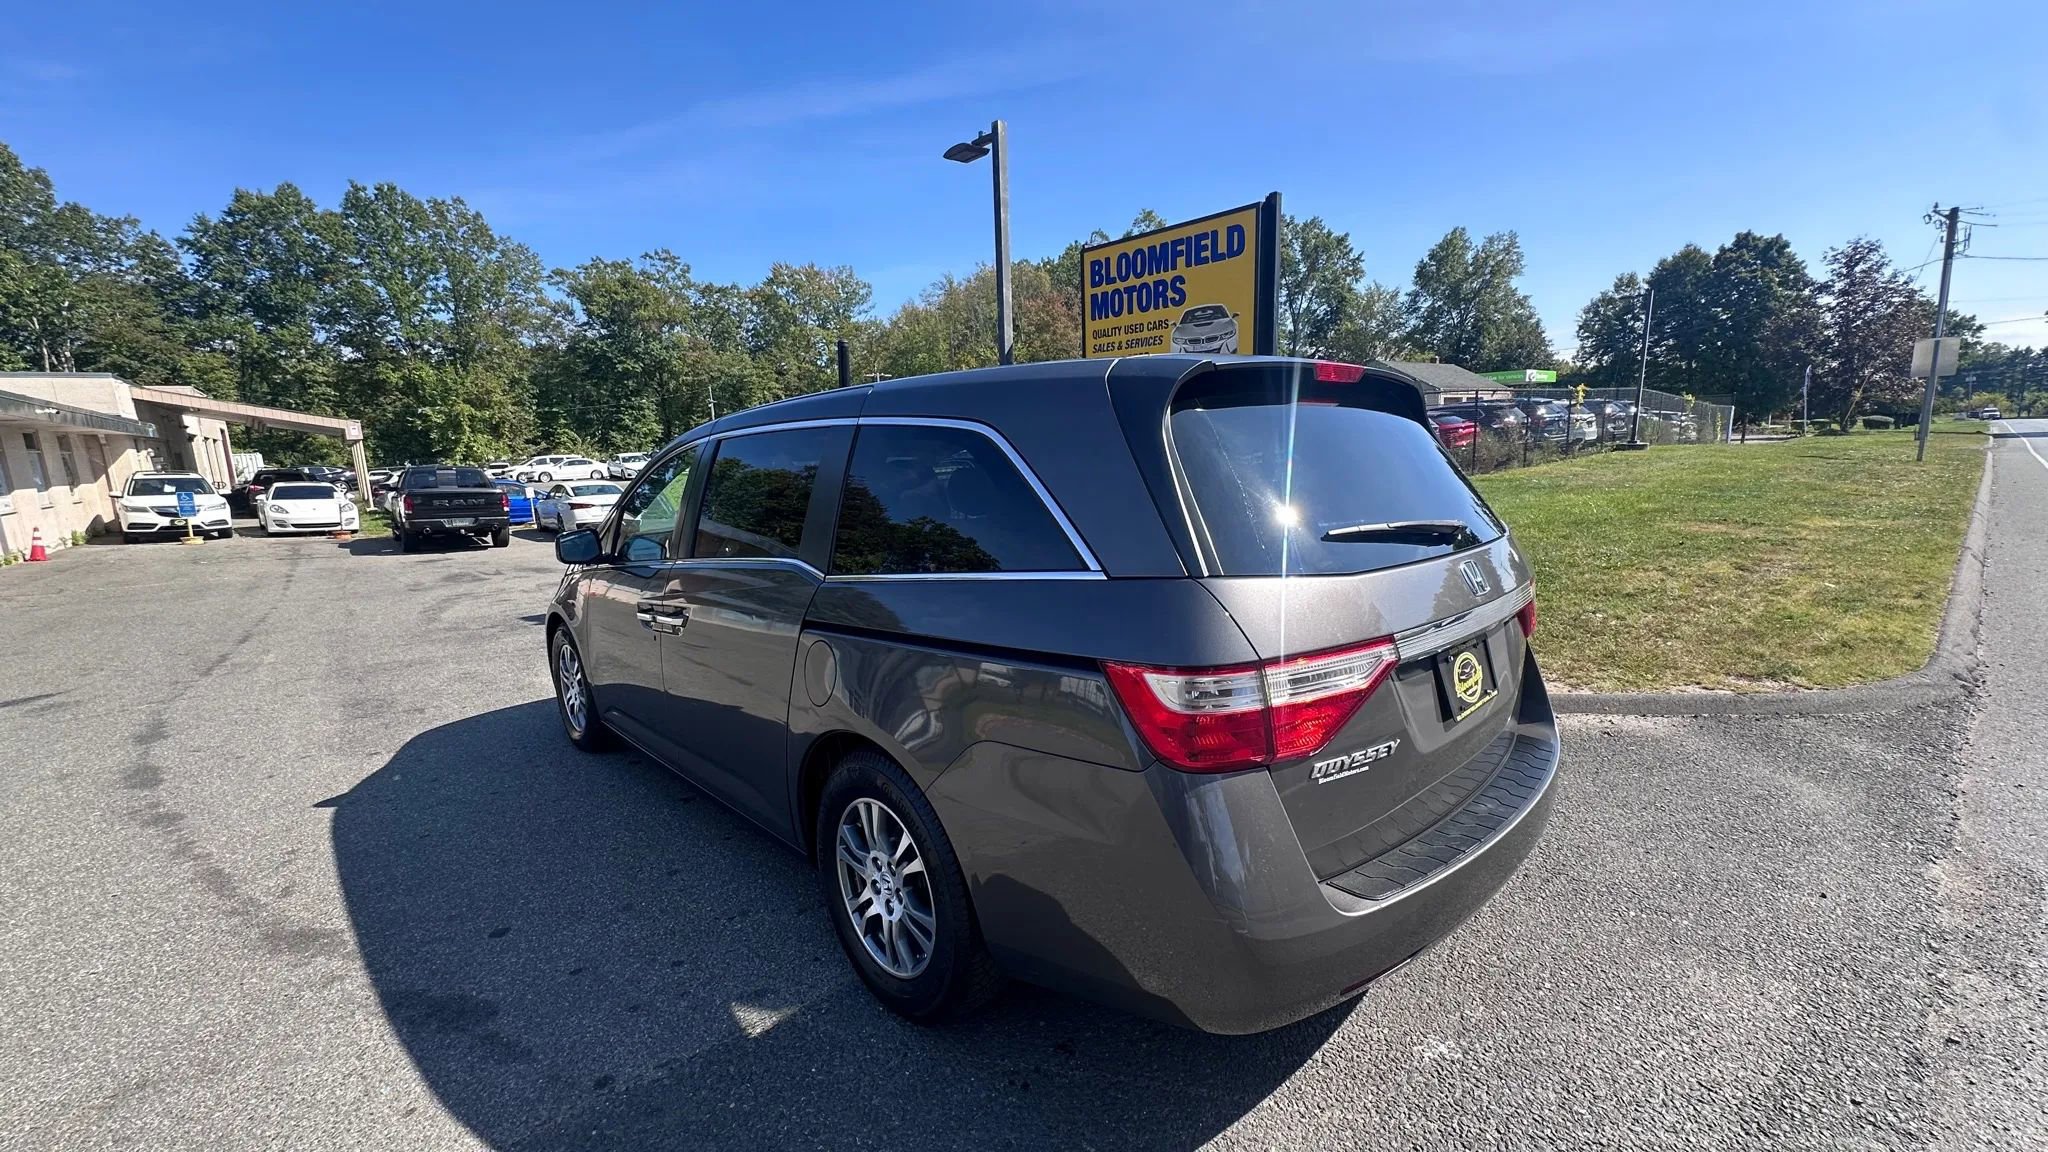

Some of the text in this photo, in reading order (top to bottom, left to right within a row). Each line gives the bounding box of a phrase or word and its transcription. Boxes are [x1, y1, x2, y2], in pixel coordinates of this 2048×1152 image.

[1090, 224, 1245, 288] BLOOMFIELD
[1090, 275, 1186, 321] MOTORS
[1093, 319, 1169, 340] QUALITY USED CARS
[1093, 335, 1163, 353] SALES & SERVICES
[1310, 738, 1400, 779] ODYSSEY
